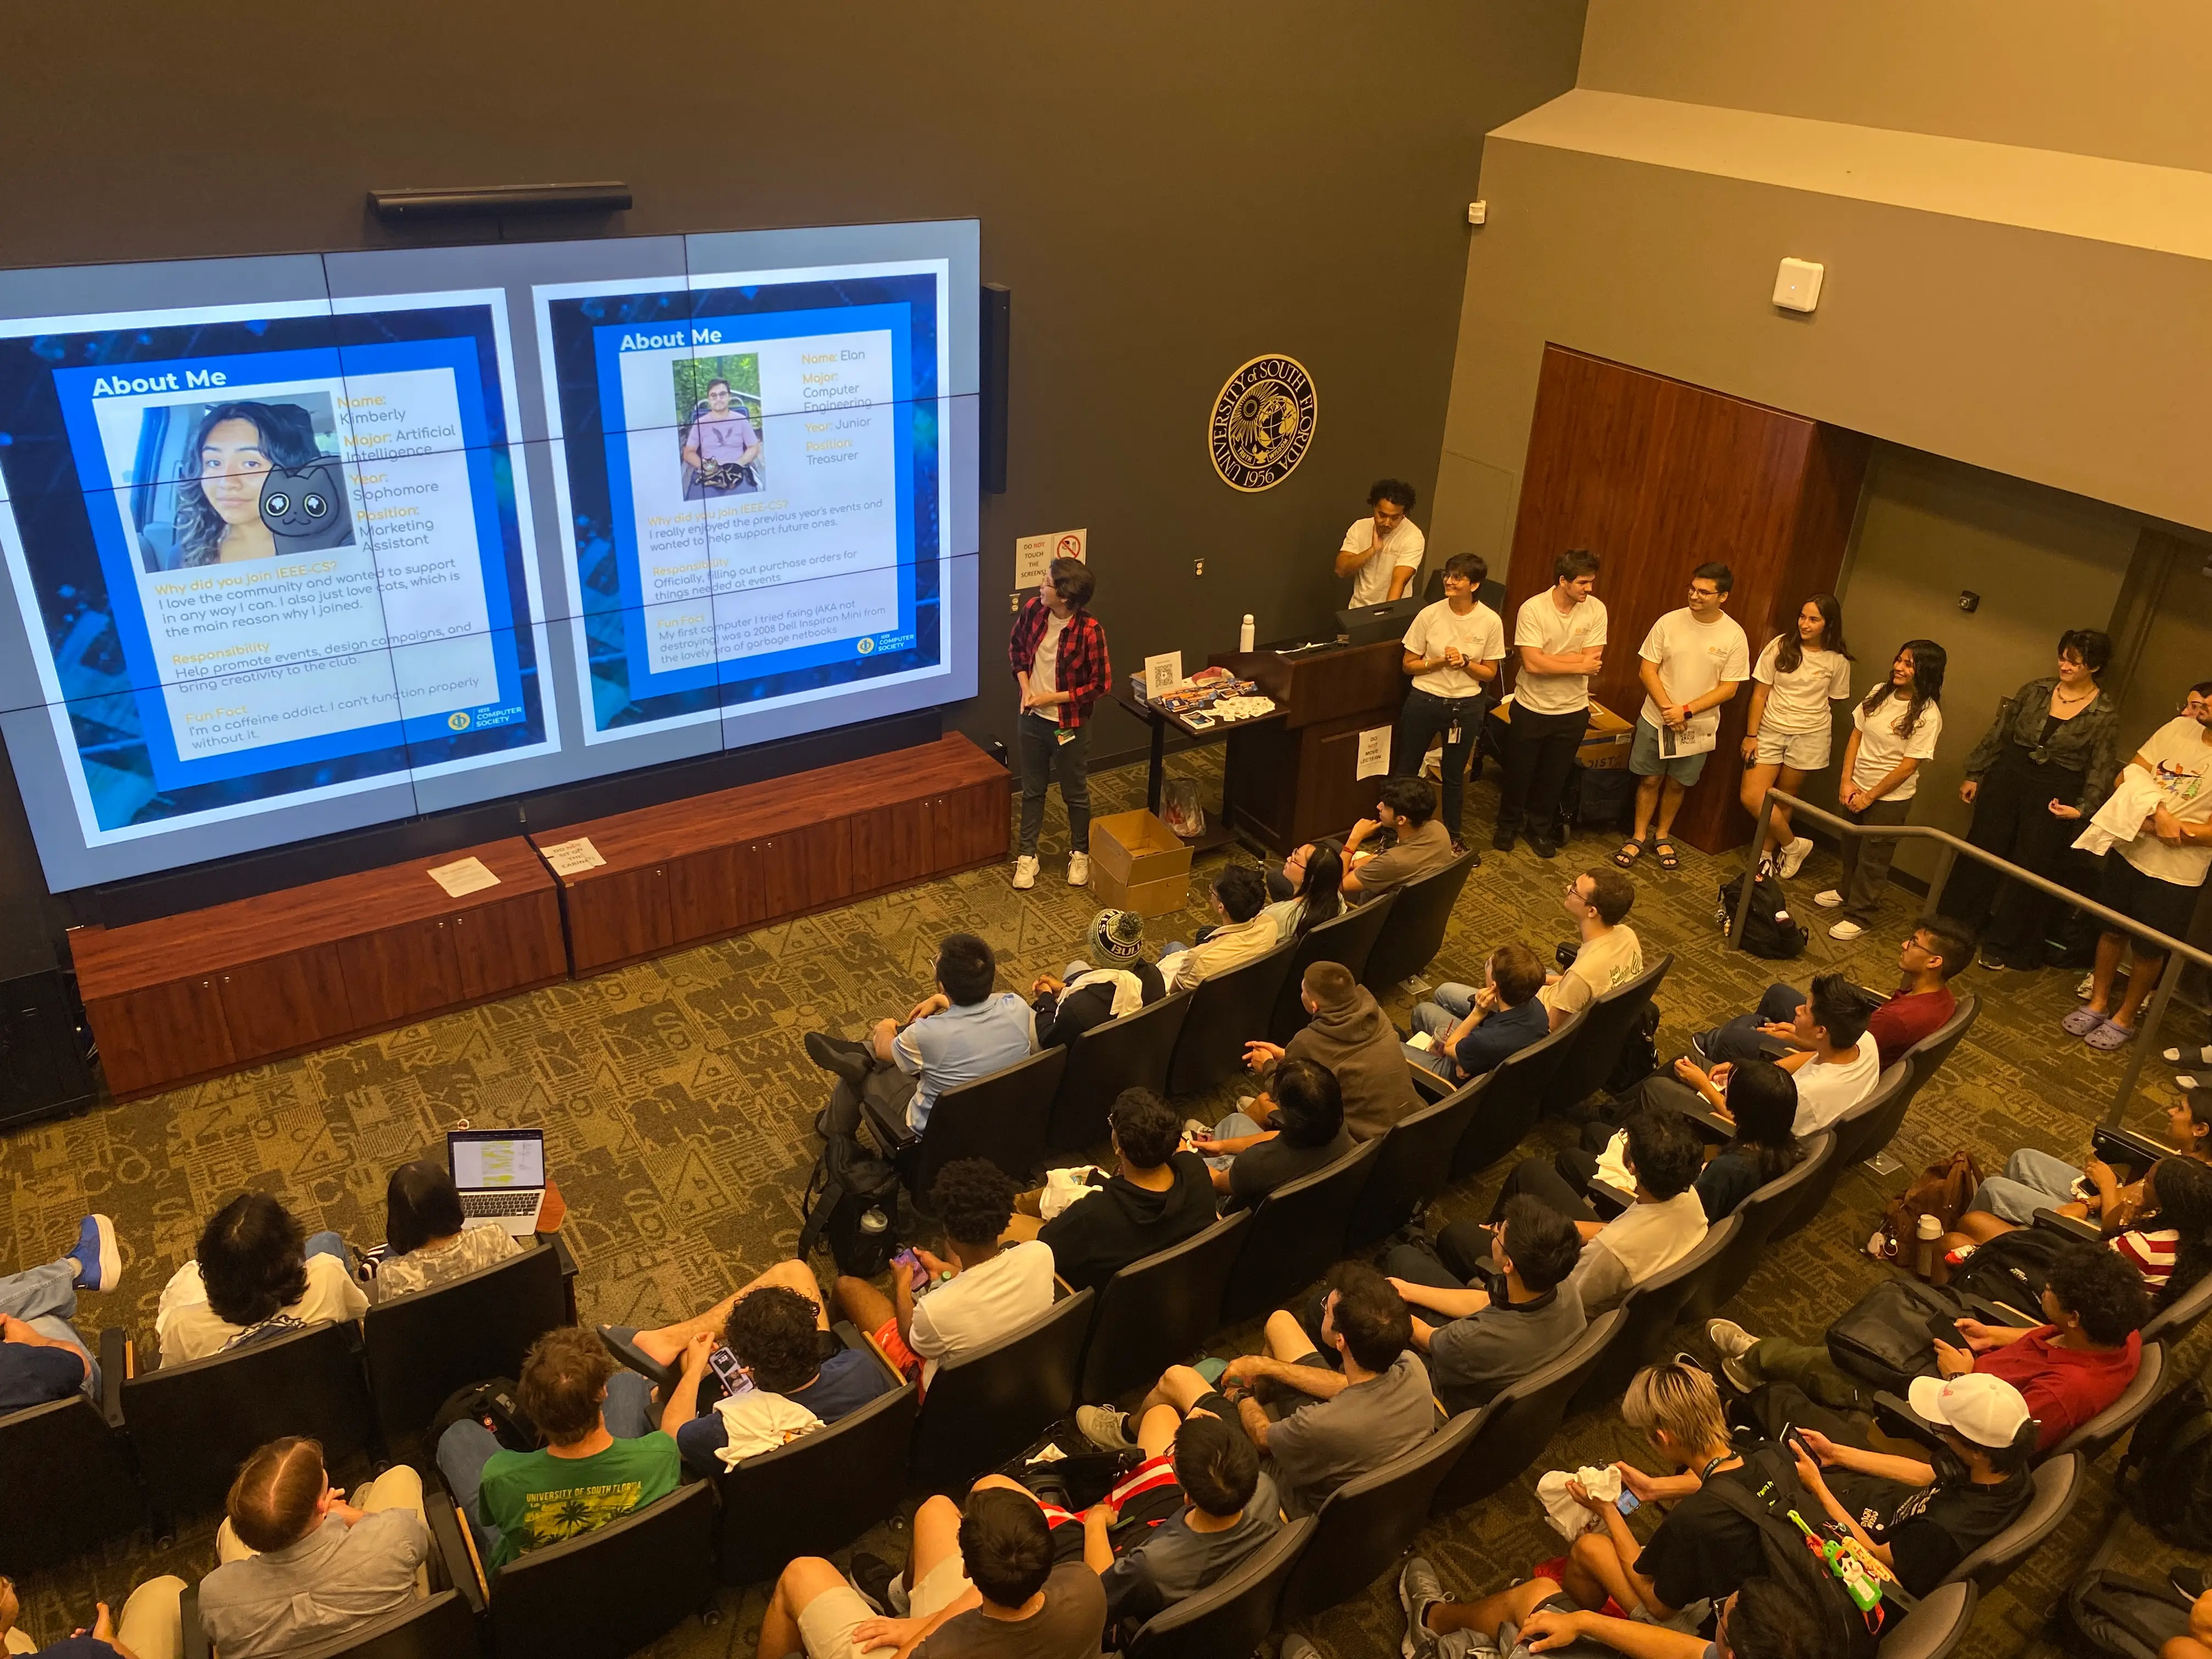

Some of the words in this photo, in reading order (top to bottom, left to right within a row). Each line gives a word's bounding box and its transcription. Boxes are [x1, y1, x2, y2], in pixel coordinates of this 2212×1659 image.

[620, 331, 685, 351] About
[691, 328, 722, 345] Me
[802, 353, 837, 365] Name:
[840, 350, 865, 361] Elan
[93, 373, 179, 397] About
[185, 369, 227, 388] Me
[803, 373, 838, 385] Major:
[1247, 367, 1257, 383] of
[1259, 360, 1306, 393] SOUTH
[803, 385, 860, 398] Computer
[337, 396, 386, 409] Name:
[804, 398, 872, 415] Engineering
[340, 409, 406, 425] Kimberly
[805, 422, 833, 433] Year:
[836, 417, 872, 430] Junior
[343, 433, 392, 448] Major:
[396, 425, 456, 442] Artificial
[1214, 373, 1245, 482] UNIVERSITY
[1277, 393, 1313, 471] FLORIDA
[346, 445, 432, 462] Intelligence
[806, 438, 853, 452] Position:
[1237, 446, 1252, 463] TRUTH
[1268, 438, 1289, 460] WISDOM
[806, 452, 859, 465] Treasurer
[349, 473, 388, 486] Year:
[1243, 467, 1275, 487] 1956
[353, 483, 439, 501] Sophomore
[357, 506, 420, 522] Position:
[648, 516, 672, 526] Why
[674, 512, 692, 523] did
[695, 511, 715, 522] you
[718, 507, 738, 519] join
[741, 499, 788, 514] IEEE-CS?
[656, 527, 686, 539] really
[688, 520, 730, 535] enjoyed
[733, 518, 751, 527] the
[753, 512, 797, 526] previous
[799, 506, 827, 521] year's
[830, 502, 861, 515] events
[864, 498, 883, 510] and
[359, 520, 435, 538] Marketing
[650, 538, 691, 552] wanted
[708, 533, 732, 545] help
[734, 526, 776, 540] support
[778, 522, 809, 534] future
[811, 518, 838, 529] ones.
[363, 534, 430, 552] Assistant
[653, 558, 729, 577] Responsibility
[654, 574, 705, 589] Officially,
[707, 569, 737, 581] filling
[739, 565, 757, 575] out
[759, 558, 807, 574] purchase
[809, 553, 842, 565] orders
[155, 583, 186, 596] Why
[190, 579, 213, 591] did
[216, 576, 243, 590] you
[246, 571, 272, 586] join
[276, 560, 337, 579] IEEE-CS?
[167, 596, 196, 608] love
[199, 592, 223, 605] the
[227, 581, 303, 600] community
[306, 575, 332, 589] and
[336, 568, 385, 584] wanted
[388, 567, 402, 577] to
[405, 558, 456, 575] support
[655, 589, 690, 602] things
[692, 580, 732, 595] needed
[748, 573, 782, 586] events
[162, 613, 176, 624] in
[180, 610, 206, 622] any
[210, 605, 236, 617] way
[248, 600, 277, 612] can.
[287, 594, 316, 605] also
[319, 588, 345, 603] just
[347, 585, 373, 597] love
[376, 580, 408, 592] cats,
[410, 573, 446, 588] which
[166, 626, 190, 638] the
[193, 620, 229, 634] main
[232, 613, 280, 628] reason
[283, 608, 309, 621] why
[318, 599, 363, 618] joined.
[659, 630, 675, 641] My
[678, 627, 698, 637] first
[701, 617, 753, 634] computer
[760, 611, 783, 624] tried
[786, 607, 814, 619] fixing
[815, 602, 837, 616] (AKA
[839, 600, 856, 610] not
[680, 614, 706, 626] Fact
[660, 635, 720, 652] destroying)
[722, 631, 742, 641] was
[753, 624, 776, 637] 2008
[778, 621, 798, 632] Dell
[799, 614, 839, 629] Inspiron
[842, 611, 862, 621] Mini
[864, 606, 886, 617] from
[661, 654, 679, 664] the
[681, 648, 711, 661] lovely
[747, 636, 790, 651] garbage
[792, 626, 837, 641] netbooks
[878, 642, 905, 652] SOCIETY
[879, 634, 915, 645] COMPUTER
[172, 642, 270, 665] Responsibility
[176, 665, 208, 679] Help
[213, 656, 272, 675] promote
[275, 647, 321, 662] events,
[325, 640, 368, 654] design
[371, 628, 445, 646] campaigns,
[448, 622, 472, 634] and
[179, 681, 218, 693] bring
[221, 669, 284, 686] creativity
[286, 665, 301, 675] to
[305, 662, 326, 672] the
[329, 656, 361, 668] club.
[185, 712, 213, 724] Fun
[216, 704, 247, 719] Fact
[188, 726, 208, 736] I'm
[224, 714, 279, 730] caffeine
[283, 703, 328, 720] addict.
[338, 696, 369, 710] can't
[372, 686, 425, 703] function
[428, 676, 479, 695] properly
[476, 706, 523, 720] COMPUTER
[476, 715, 510, 728] SOCIETY
[191, 732, 245, 749] without
[1361, 755, 1381, 764] LECTERN
[526, 1488, 572, 1502] UNIVERSITY
[574, 1487, 584, 1496] OF
[586, 1485, 611, 1495] SOUTH
